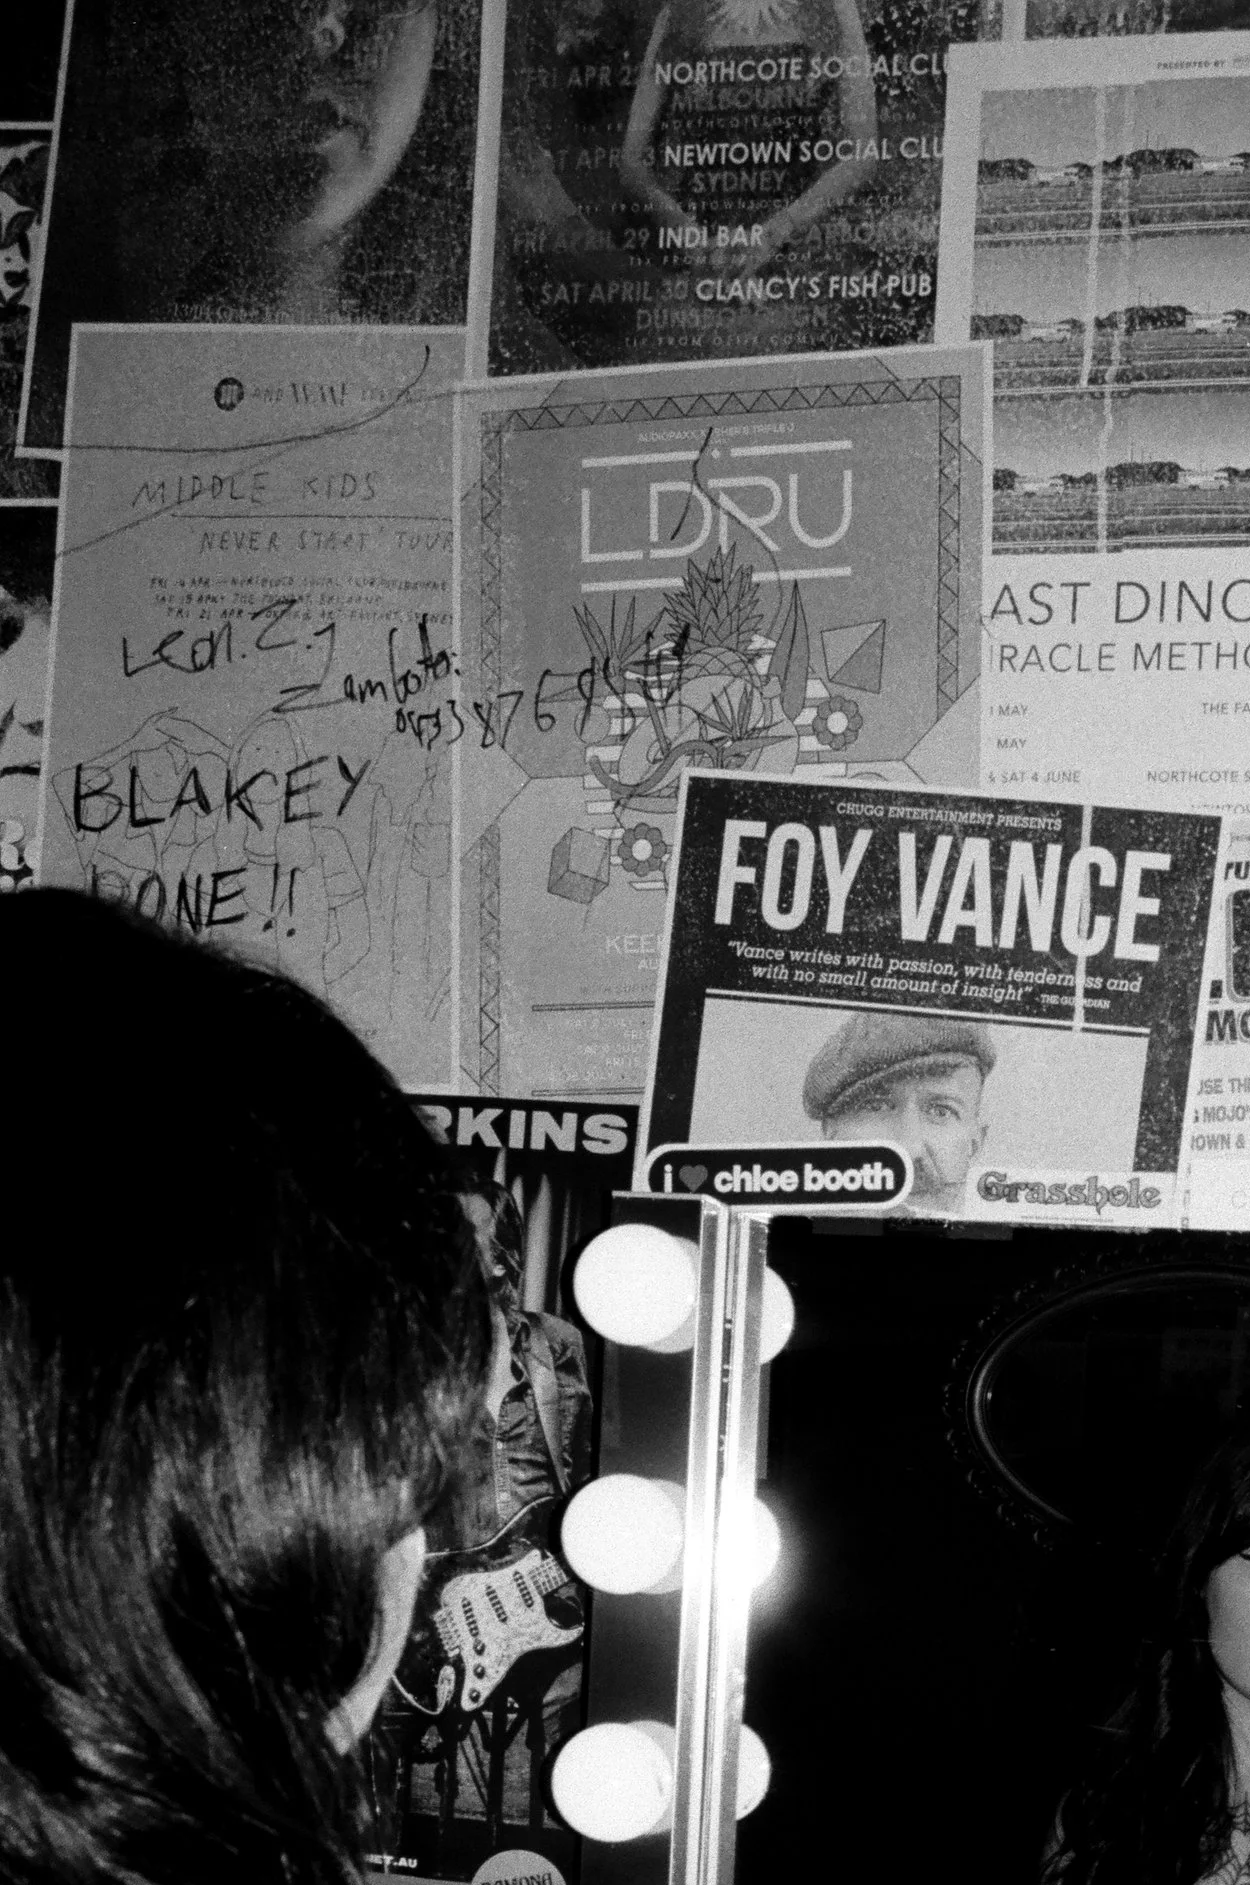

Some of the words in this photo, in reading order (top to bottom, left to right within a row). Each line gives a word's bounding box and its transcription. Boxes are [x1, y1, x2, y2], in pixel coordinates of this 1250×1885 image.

[568, 65, 611, 87] APR
[655, 58, 803, 86] NORTHCOTE
[809, 54, 902, 79] SOCIAL
[664, 141, 792, 167] NEWTOWN
[800, 138, 893, 163] SOCIAL
[900, 136, 944, 160] CLU
[693, 170, 786, 194] SYDNEY
[623, 228, 651, 249] 29
[658, 225, 709, 249] INDI
[716, 223, 764, 248] BAR
[541, 281, 582, 304] SAT
[589, 279, 653, 304] APRIL
[695, 277, 821, 303] CLANCY'S
[829, 271, 878, 299] FISH
[887, 273, 933, 297] PUB
[131, 471, 270, 509] MIDDLE
[302, 470, 378, 502] KIDS
[581, 468, 853, 564] LDRU
[200, 529, 280, 554] NEVER
[991, 581, 1092, 625] AST
[991, 642, 1117, 673] RACLE
[997, 704, 1029, 717] MAY
[1201, 701, 1229, 715] THE
[996, 737, 1028, 750] MAY
[1001, 770, 1028, 783] SAT
[1031, 771, 1040, 783] 4
[1044, 769, 1082, 784] JUNE
[1147, 770, 1240, 784] NORTHCOTE
[73, 753, 372, 833] BLAKEY
[835, 802, 886, 818] CHUGG
[888, 805, 995, 826] ENTERTAINMENT
[995, 813, 1064, 832] PRESENTS
[715, 818, 873, 935] FOY
[898, 830, 1172, 962] VANCE
[752, 963, 789, 981] with
[793, 969, 816, 983] no
[819, 970, 867, 987] small
[870, 977, 938, 994] amount
[941, 979, 960, 996] of
[789, 948, 842, 966] writes
[846, 952, 884, 970] with
[887, 957, 958, 978] passion,
[964, 963, 1003, 980] with
[1007, 967, 1104, 990] tendernss
[1105, 975, 1144, 994] and
[1060, 995, 1112, 1010] GUDIAN
[1191, 1133, 1232, 1151] OWN
[1234, 1132, 1246, 1150] &
[662, 1164, 674, 1195] i
[714, 1166, 800, 1193] chloe
[803, 1162, 896, 1191] booth
